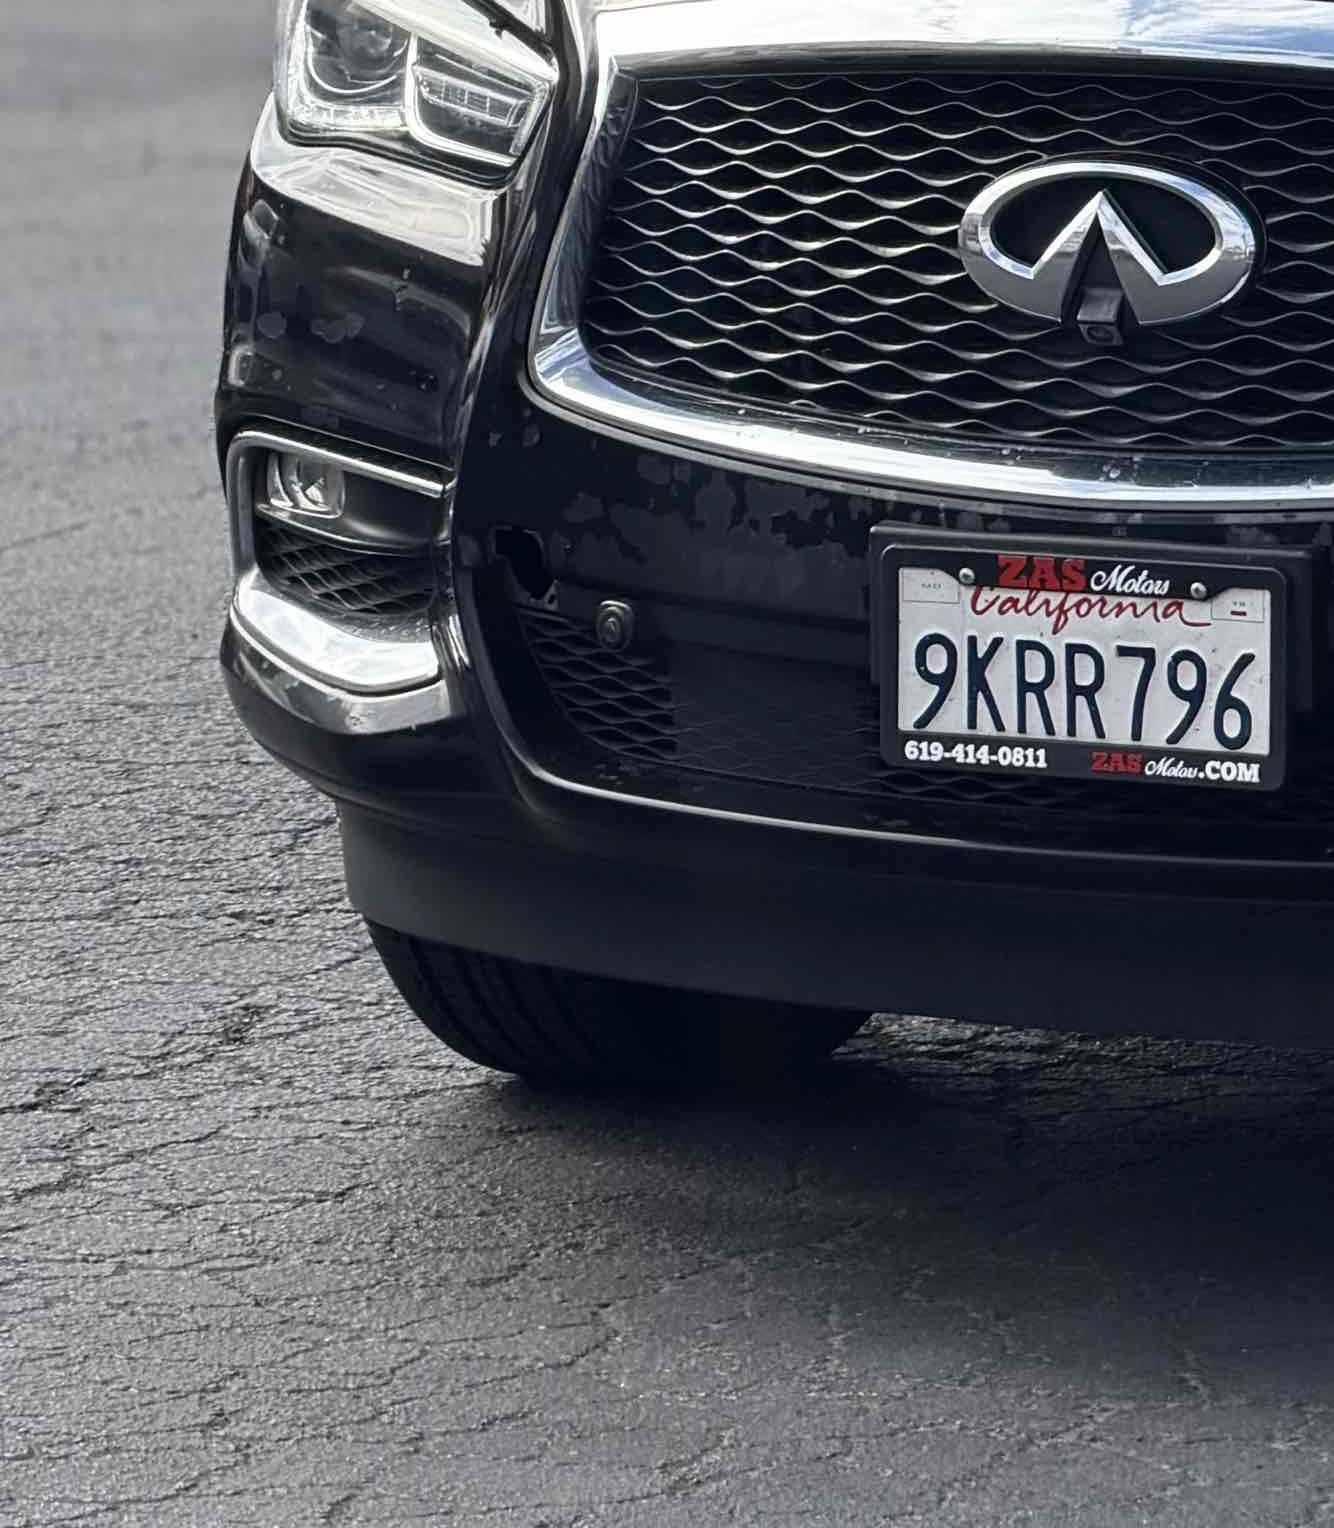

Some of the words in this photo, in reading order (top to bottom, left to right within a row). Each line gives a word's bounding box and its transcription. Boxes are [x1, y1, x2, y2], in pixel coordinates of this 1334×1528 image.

[997, 554, 1088, 592] ZAS
[1090, 563, 1170, 596] Motors
[970, 584, 1212, 635] California
[913, 632, 1256, 751] 9KRR796
[904, 740, 1048, 769] 619-414-0811
[1090, 751, 1144, 775] ZAS
